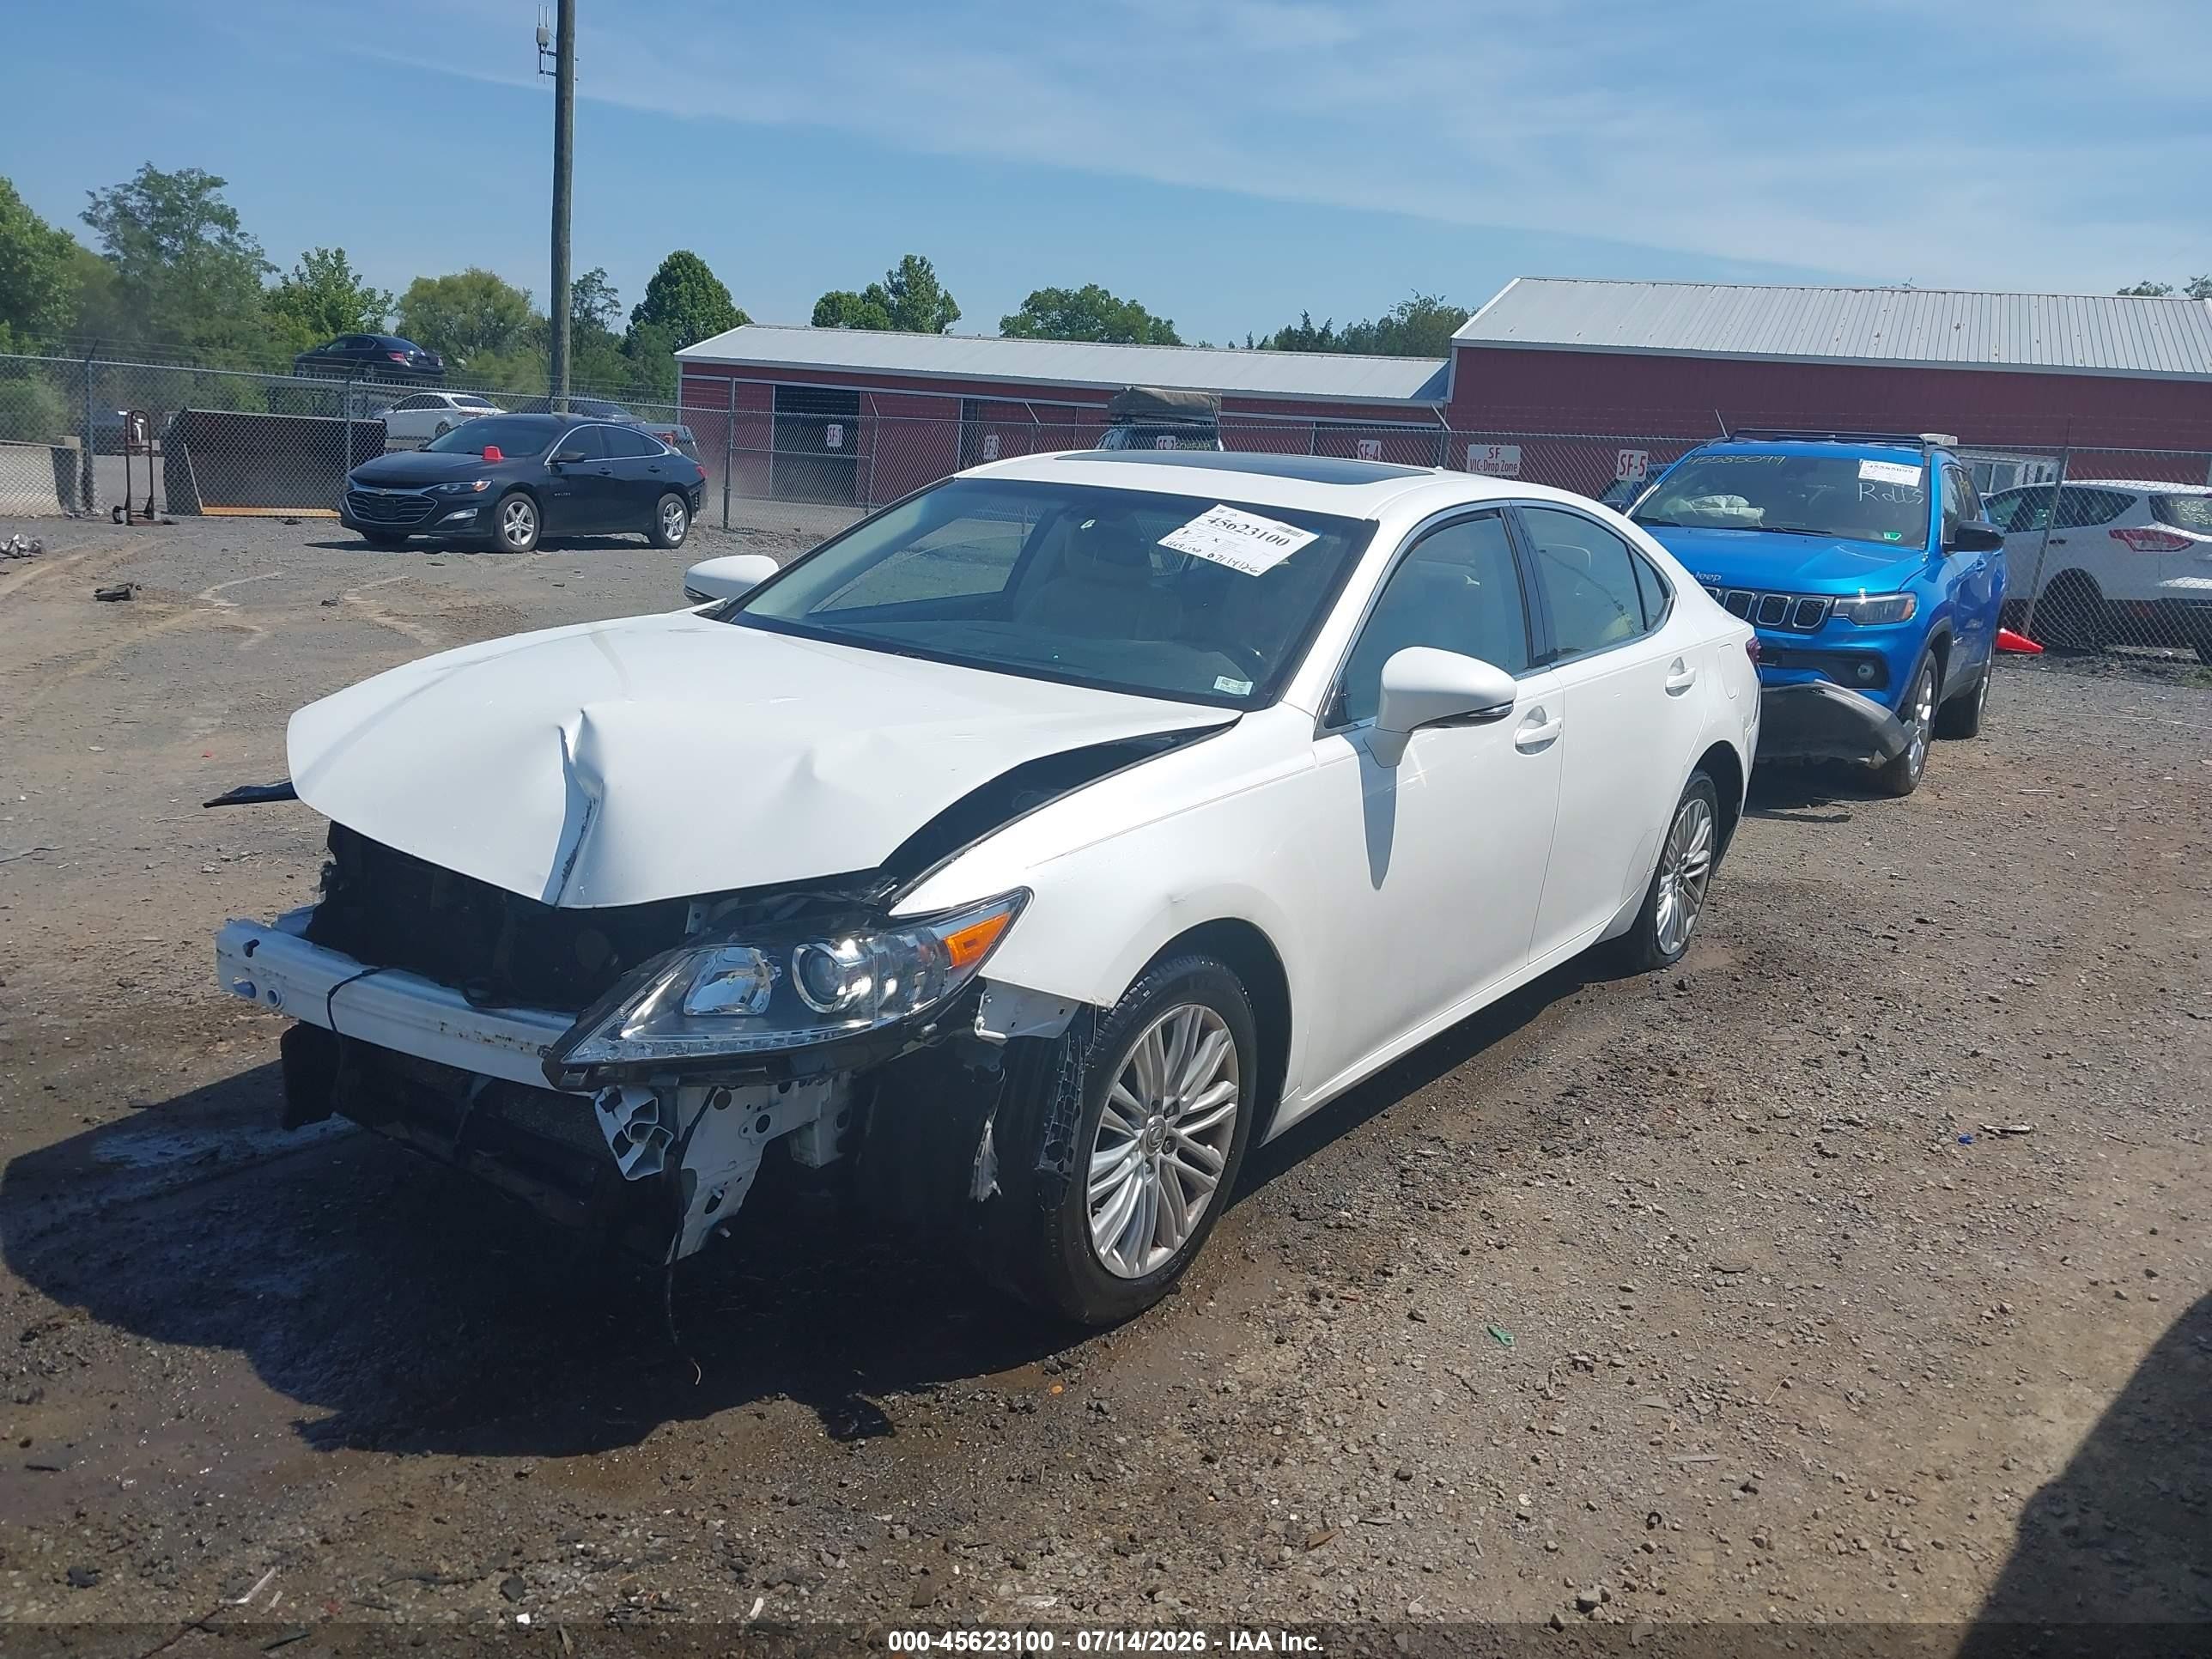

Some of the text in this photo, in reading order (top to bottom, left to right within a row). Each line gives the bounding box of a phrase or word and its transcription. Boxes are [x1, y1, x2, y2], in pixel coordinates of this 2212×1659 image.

[1359, 443, 1379, 460] SF-4
[1488, 447, 1501, 459] SF
[1469, 459, 1518, 473] VIC-Drop Zone
[1620, 454, 1646, 477] SF-5
[1206, 517, 1291, 547] 45623100
